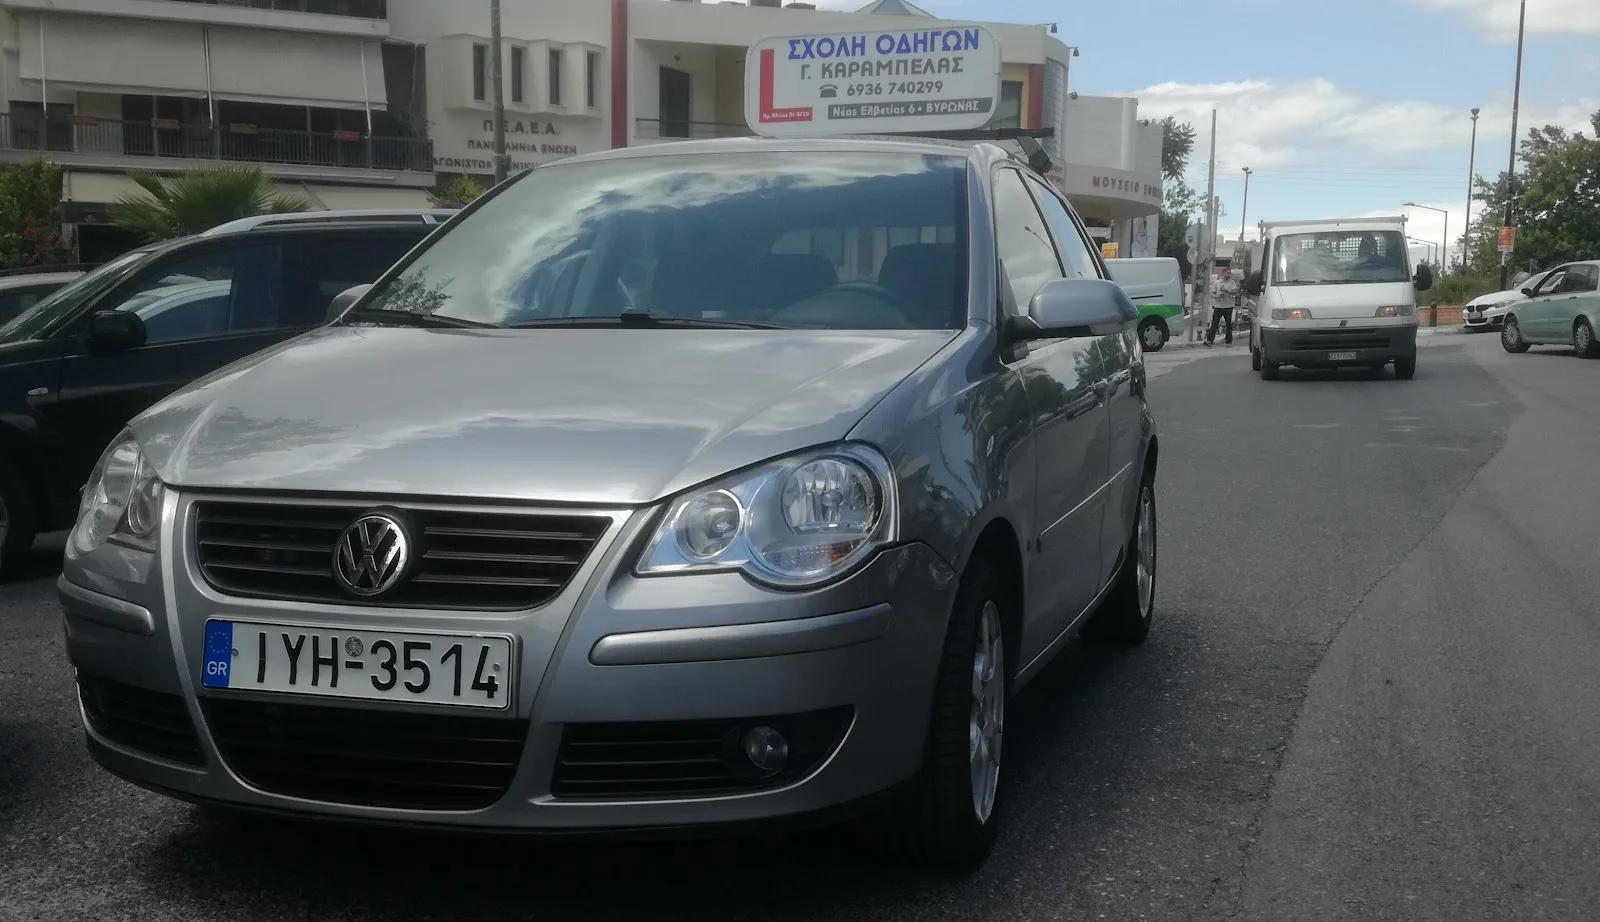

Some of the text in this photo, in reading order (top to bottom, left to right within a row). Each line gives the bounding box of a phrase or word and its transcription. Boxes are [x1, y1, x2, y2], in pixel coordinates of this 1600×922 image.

[788, 29, 979, 60] ΣΧΟΛΗ ΟΔΗΓΩΝ
[801, 56, 963, 80] Γ. ΚΑΡΑΜΠΕΛΑΣ
[846, 80, 944, 97] 6936 740299
[832, 101, 979, 118] Νέας Ελβετίας 6 ΒΥΡΩΝΑΣ
[1092, 175, 1140, 193] ΜΟΥΣΕΙΟ
[206, 660, 228, 676] GR
